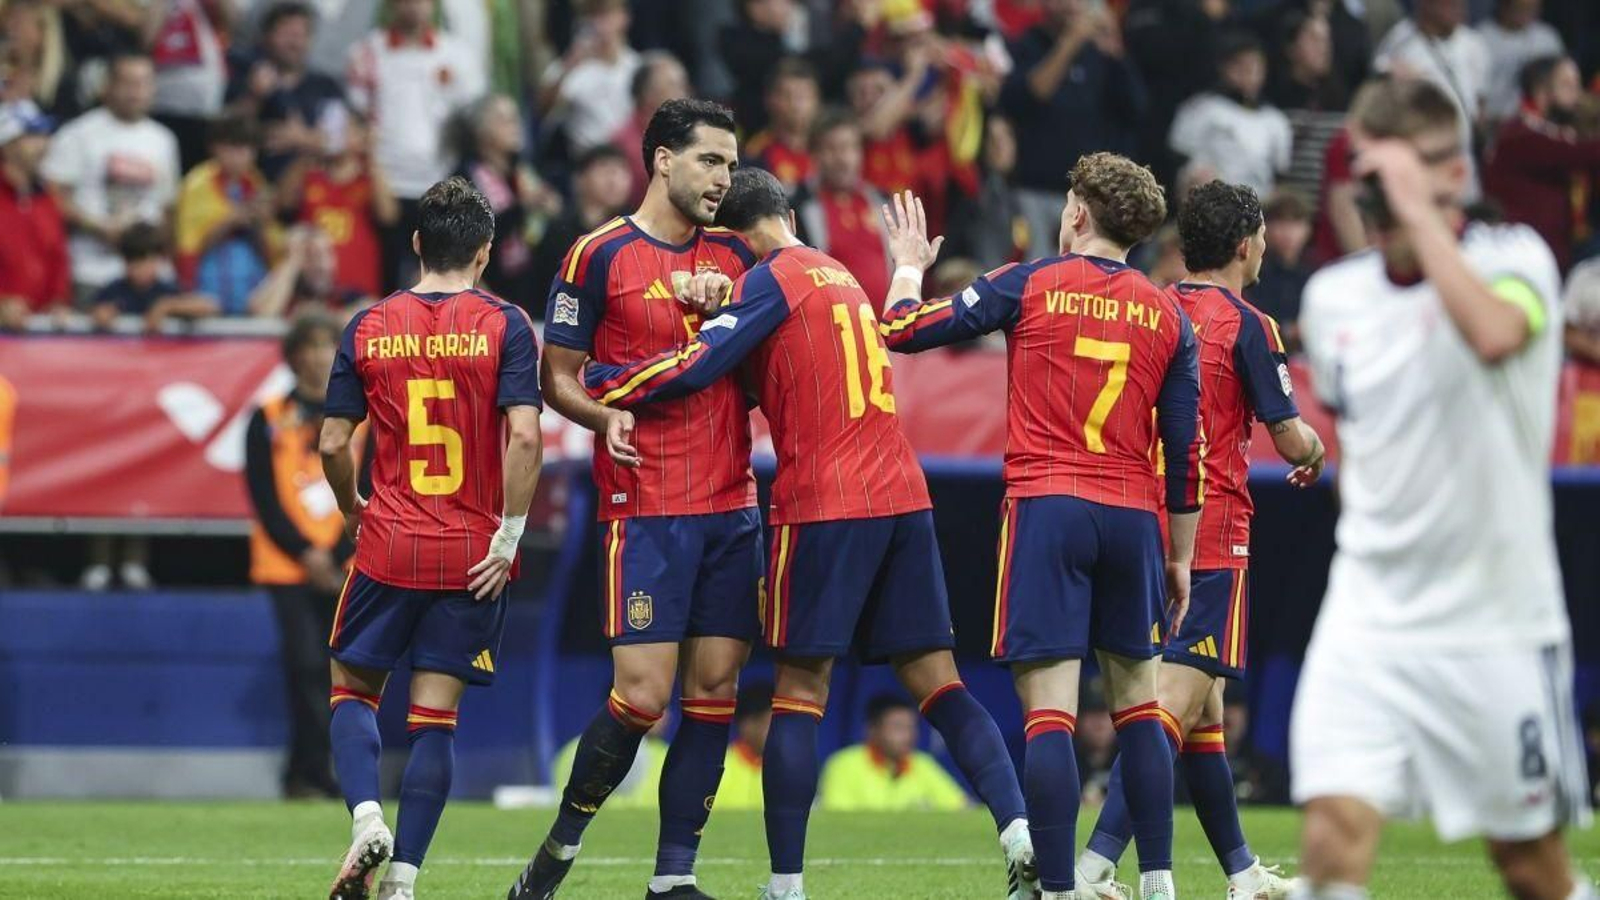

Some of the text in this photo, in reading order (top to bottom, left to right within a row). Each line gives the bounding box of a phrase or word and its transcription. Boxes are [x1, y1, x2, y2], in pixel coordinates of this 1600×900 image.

[367, 329, 489, 359] FRAN GARCÍA
[1045, 290, 1163, 334] VICTOR M.V.
[1074, 335, 1131, 454] 7
[406, 378, 464, 496] 5
[1518, 714, 1547, 781] 8
